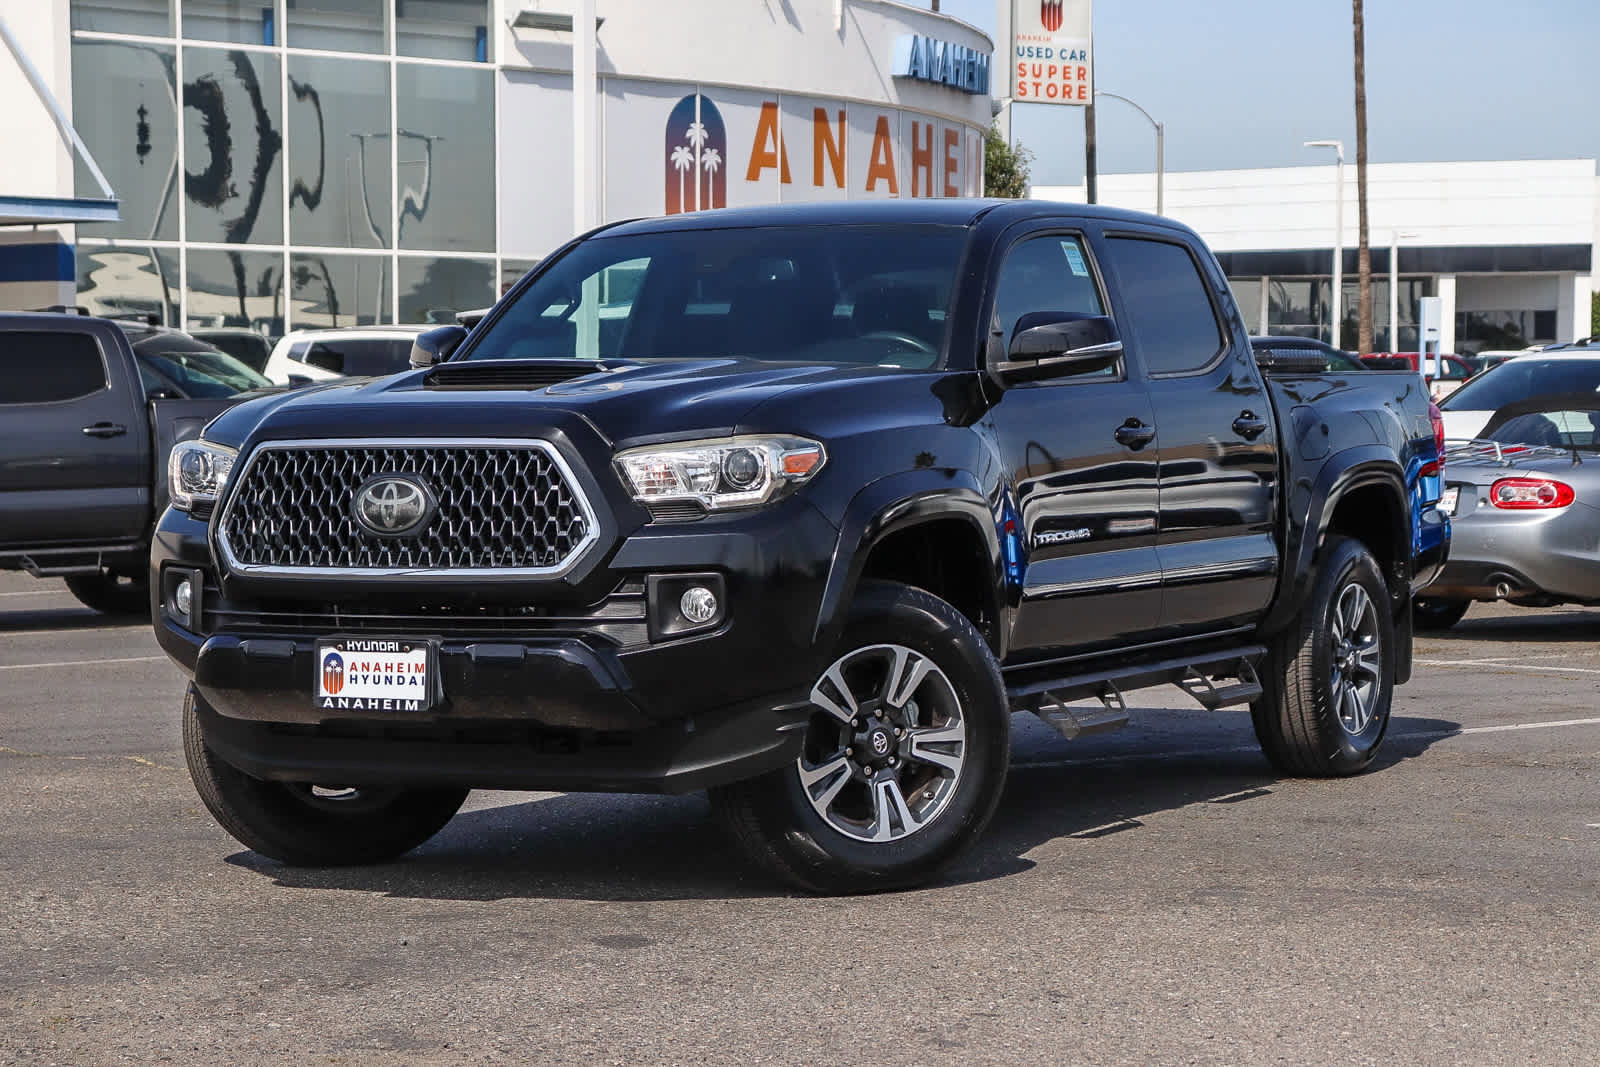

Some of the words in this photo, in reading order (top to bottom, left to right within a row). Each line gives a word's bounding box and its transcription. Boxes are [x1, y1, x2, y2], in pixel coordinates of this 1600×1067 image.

[1016, 46, 1054, 59] USED
[1059, 48, 1087, 61] CAR
[908, 33, 990, 95] ANAHEIM
[1018, 62, 1087, 81] SUPER
[1018, 81, 1088, 100] STORE
[1035, 528, 1092, 544] TACOMA
[346, 641, 399, 652] HYUNDAI
[349, 661, 425, 674] ANAHEIM
[349, 674, 425, 686] HYUNDAI
[323, 698, 418, 711] ANAHEIM
